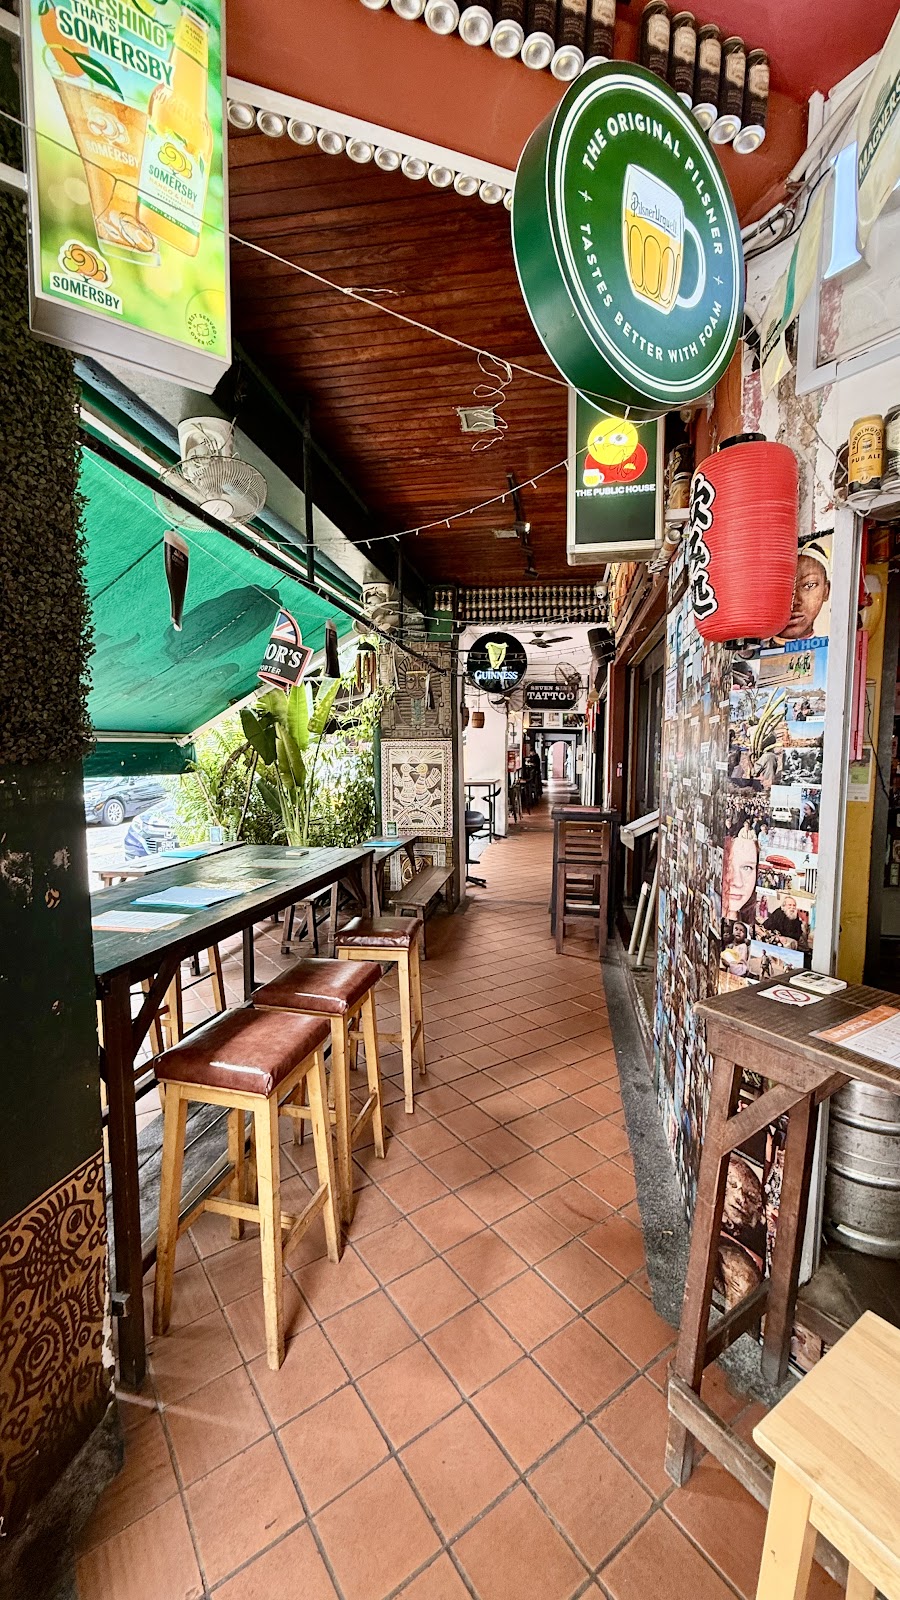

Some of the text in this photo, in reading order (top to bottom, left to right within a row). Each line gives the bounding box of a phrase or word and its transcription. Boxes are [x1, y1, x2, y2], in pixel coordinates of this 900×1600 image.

[74, 1, 117, 33] THAT'S
[58, 10, 174, 87] SOMERSBY
[148, 164, 198, 203] SOMERSBY
[582, 112, 723, 255] THE ORIGINAL PILSNER
[52, 275, 120, 310] SOMERSBY
[580, 223, 722, 363] TASTES BETTER WITH FOAM
[575, 484, 656, 497] THE PUBLIC HOUSE
[264, 643, 303, 668] OR'S
[785, 637, 829, 652] IN HOT
[260, 664, 281, 675] ORTER
[474, 669, 519, 680] GUINNESS
[526, 691, 575, 700] TATTOO
